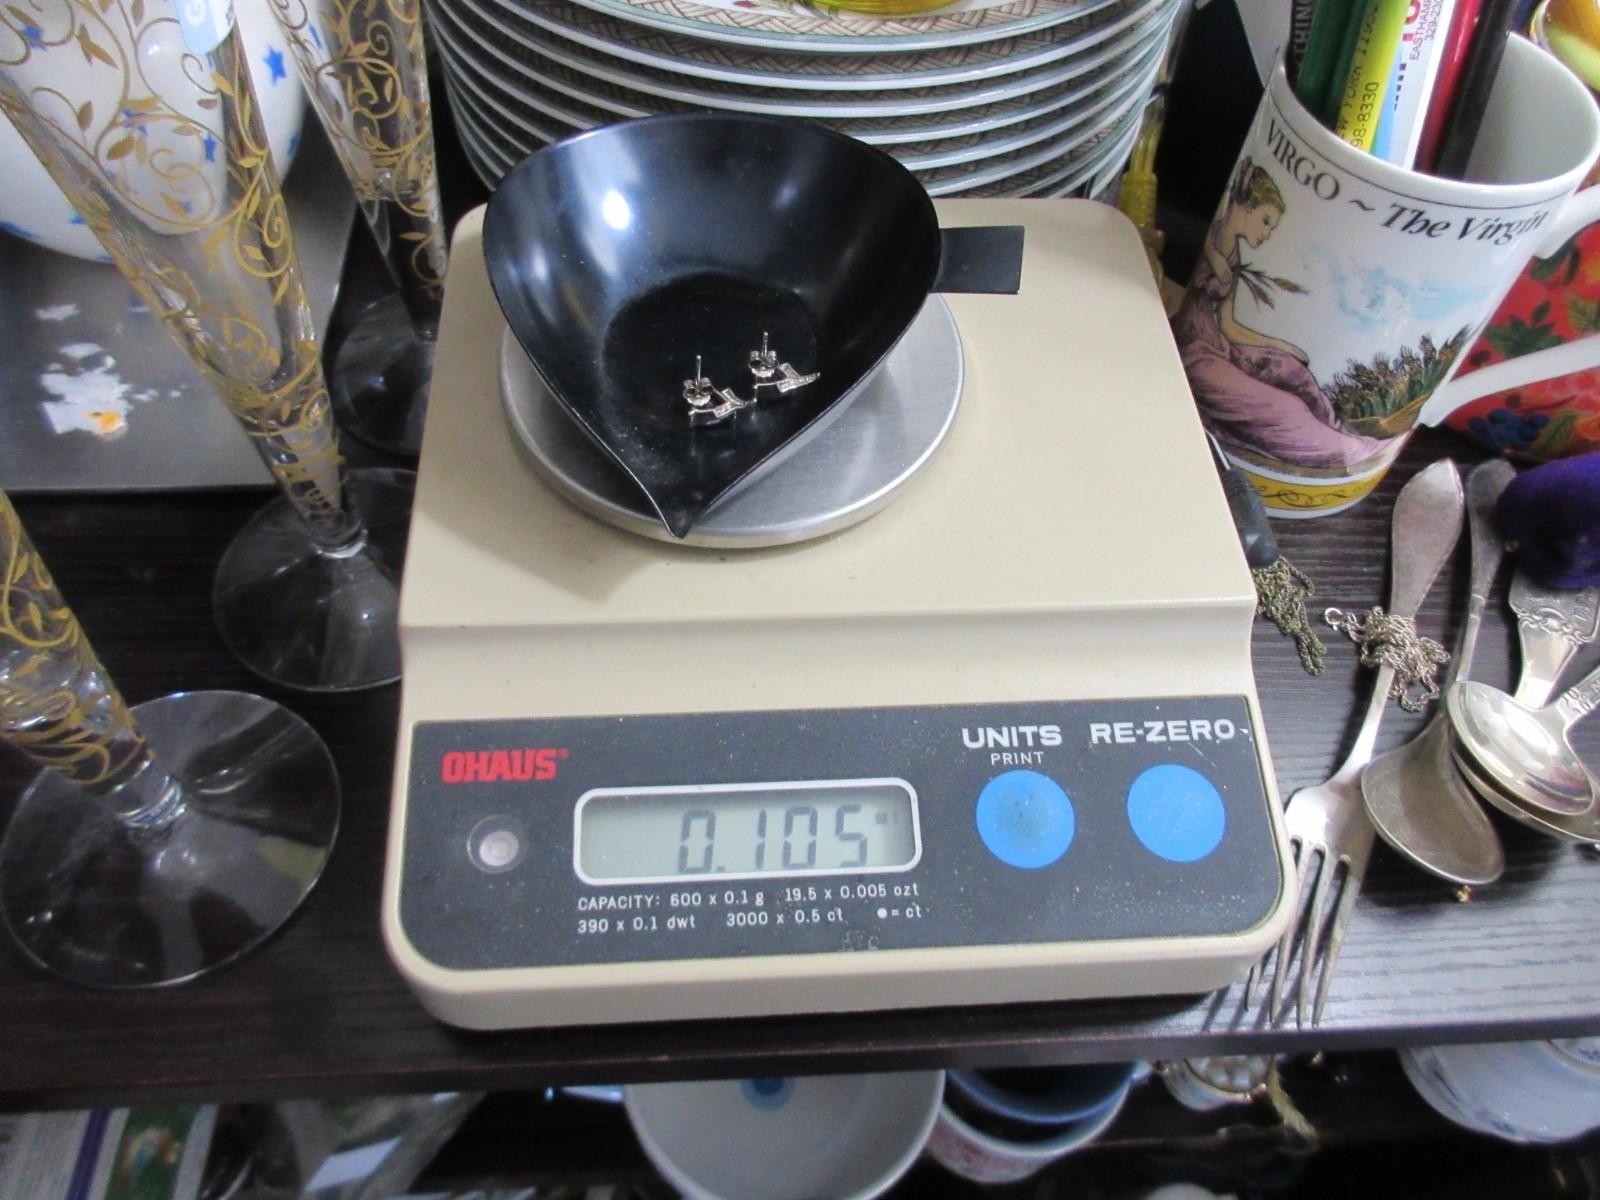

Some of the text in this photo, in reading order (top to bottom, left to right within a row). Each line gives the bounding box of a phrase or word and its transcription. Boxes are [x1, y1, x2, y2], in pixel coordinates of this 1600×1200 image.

[1351, 82, 1379, 147] 98-8330
[1267, 119, 1340, 201] VIRGO
[1380, 203, 1451, 238] The
[1457, 209, 1549, 245] Virgin
[962, 724, 1063, 749] UNITS
[1089, 718, 1236, 745] RE-ZERO
[442, 747, 558, 784] OHAUS
[990, 751, 1045, 766] PRINT
[678, 802, 870, 876] 0.105
[577, 882, 919, 911] CAPACITY: 600 x 0.1 g 19.5 x 0.005 ozt
[577, 918, 609, 934] 390
[616, 920, 625, 932] x
[633, 916, 658, 931] 0.1
[667, 914, 696, 929] dwt
[726, 911, 768, 927] 3000
[776, 913, 784, 925] x
[794, 908, 821, 924] 0.5
